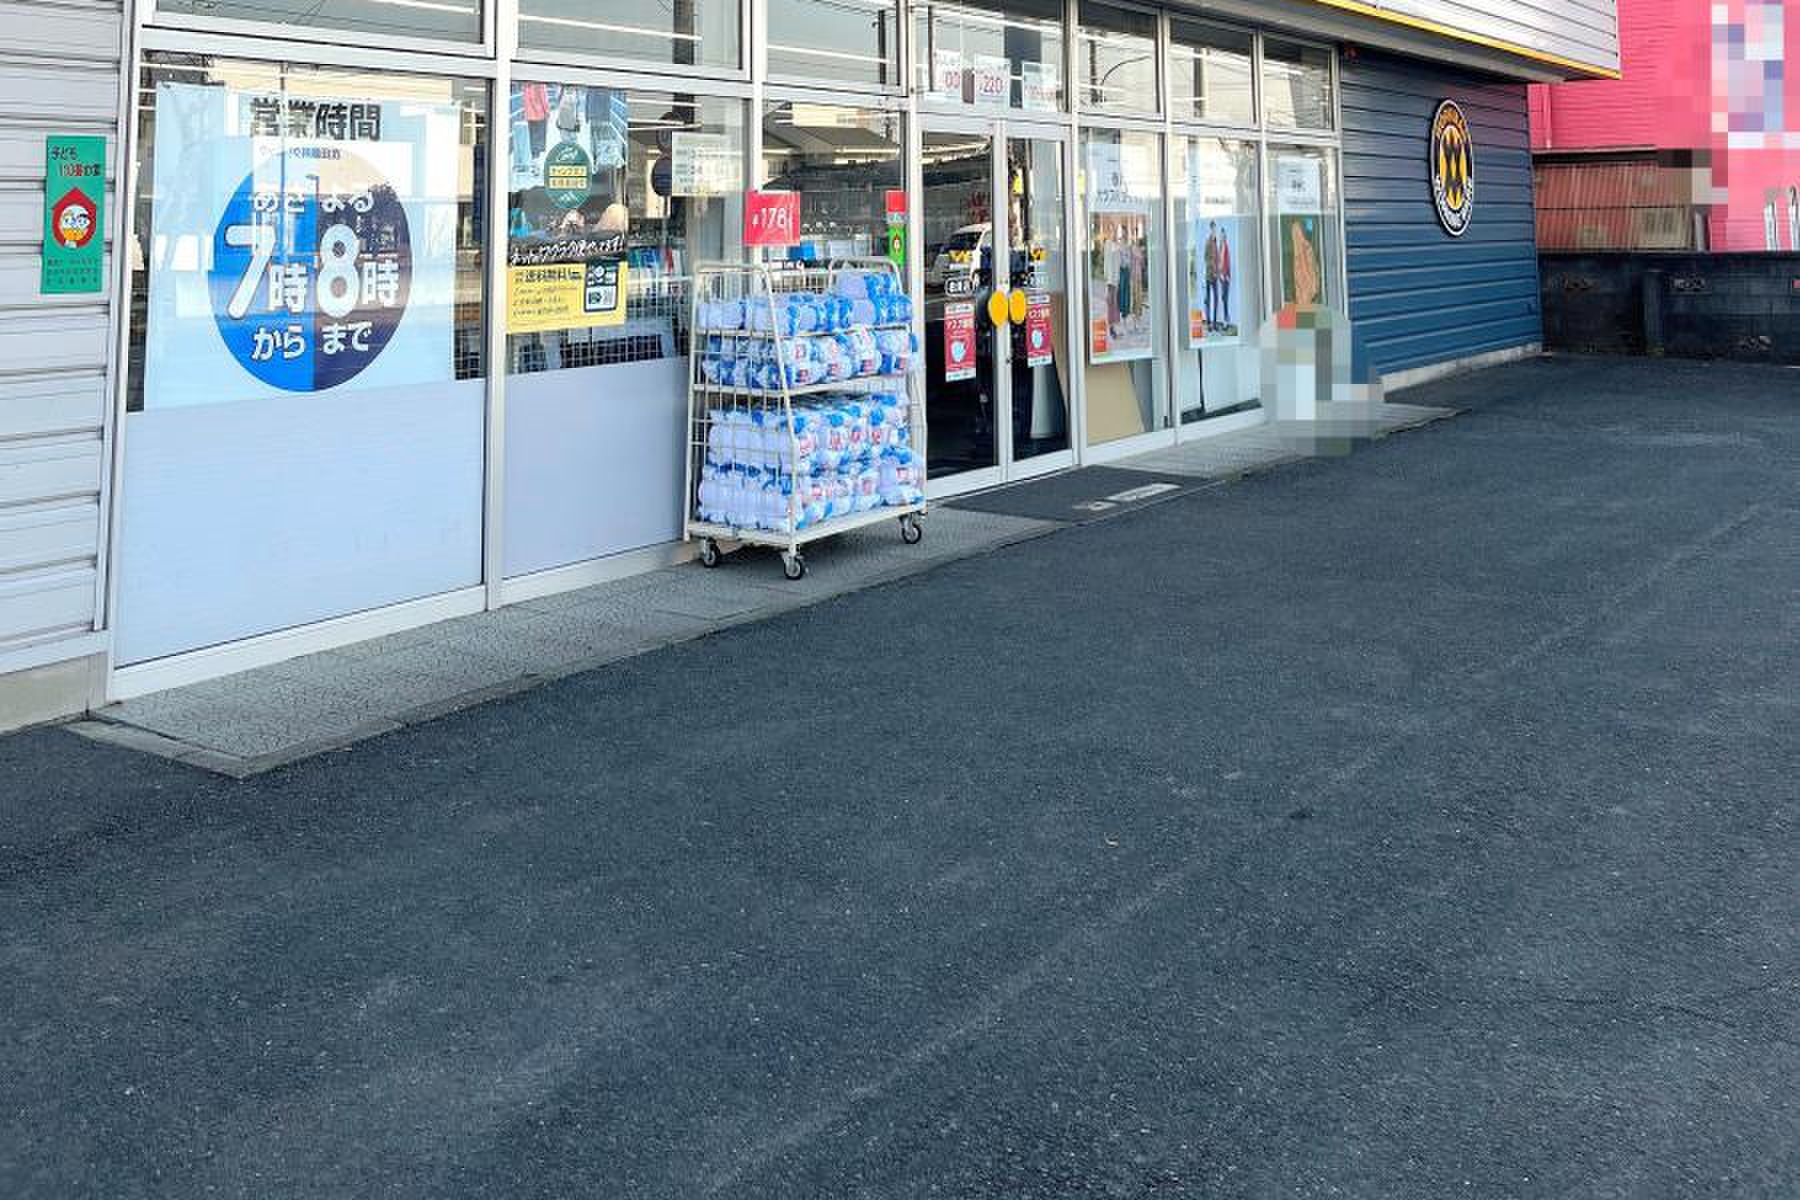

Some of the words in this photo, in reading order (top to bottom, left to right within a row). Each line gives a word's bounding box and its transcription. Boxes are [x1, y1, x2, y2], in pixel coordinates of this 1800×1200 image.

[250, 97, 381, 141] 営業時間
[251, 324, 306, 360] から
[321, 320, 373, 354] まで
